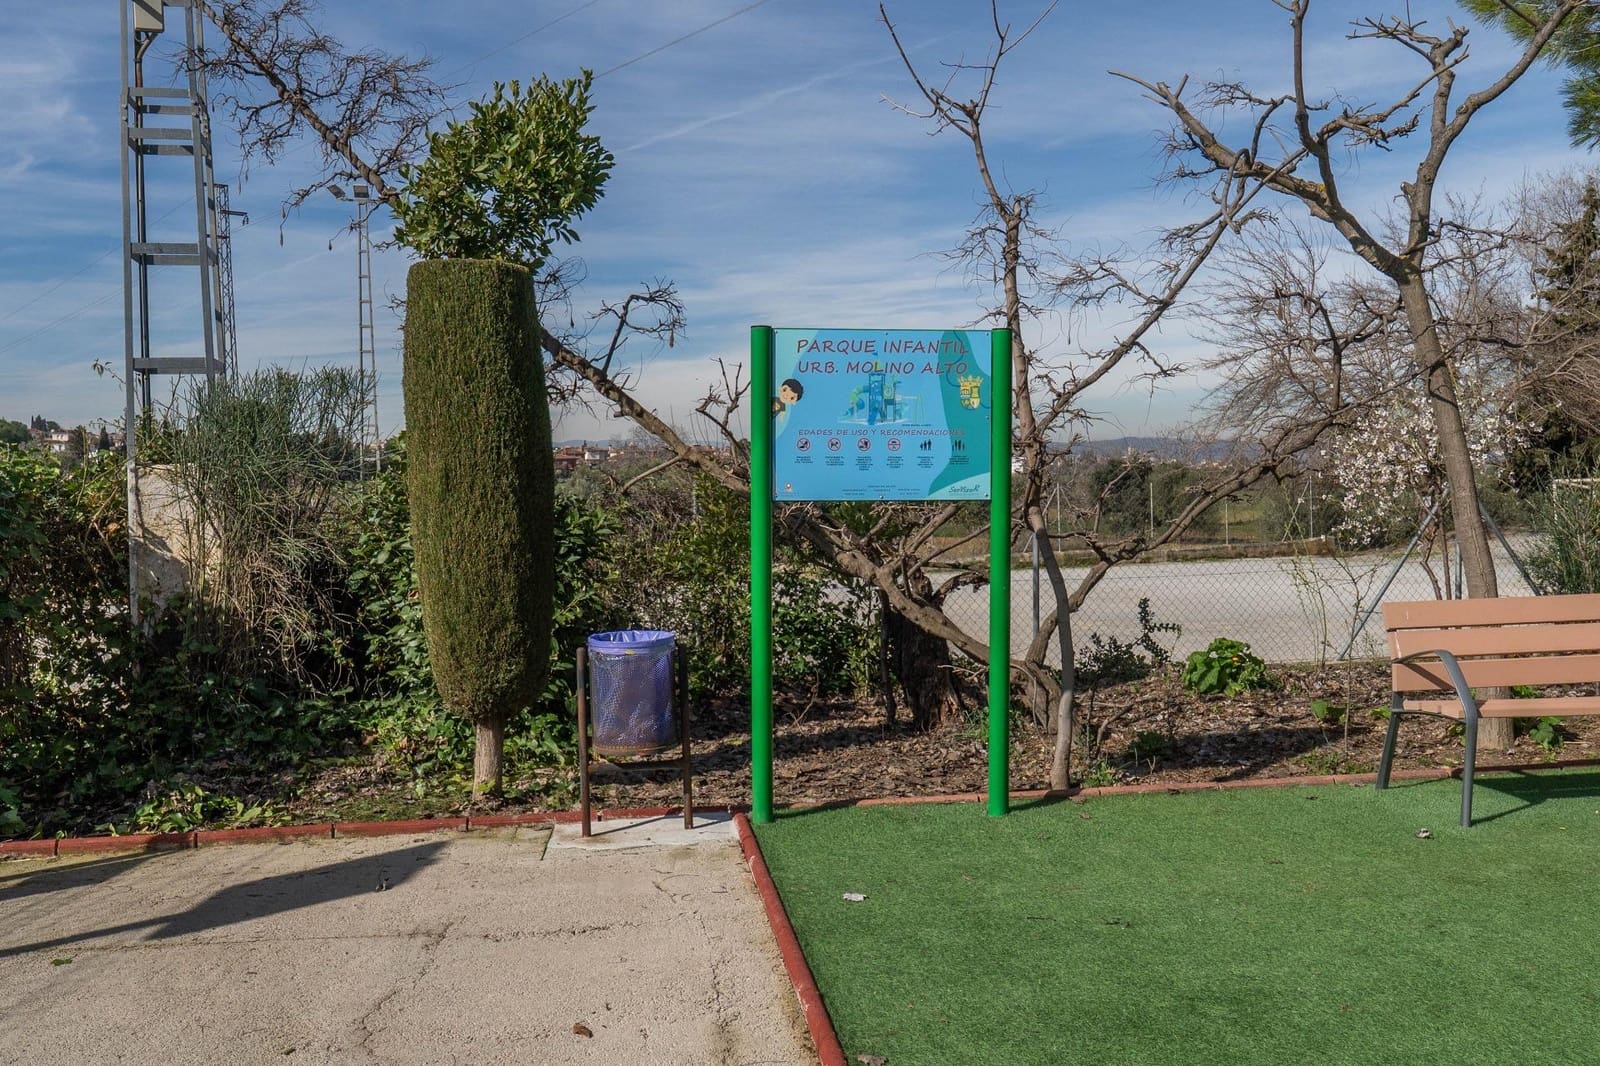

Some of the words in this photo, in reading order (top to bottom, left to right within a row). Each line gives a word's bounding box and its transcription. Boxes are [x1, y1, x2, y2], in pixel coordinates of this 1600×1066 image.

[797, 339, 876, 354] PARQUE
[883, 340, 969, 354] INFANTIL
[799, 361, 839, 374] URB.
[846, 361, 914, 374] MOLINO
[921, 362, 968, 374] ALTO
[798, 429, 833, 437] EDADES
[836, 429, 849, 437] DE
[852, 429, 868, 437] USO
